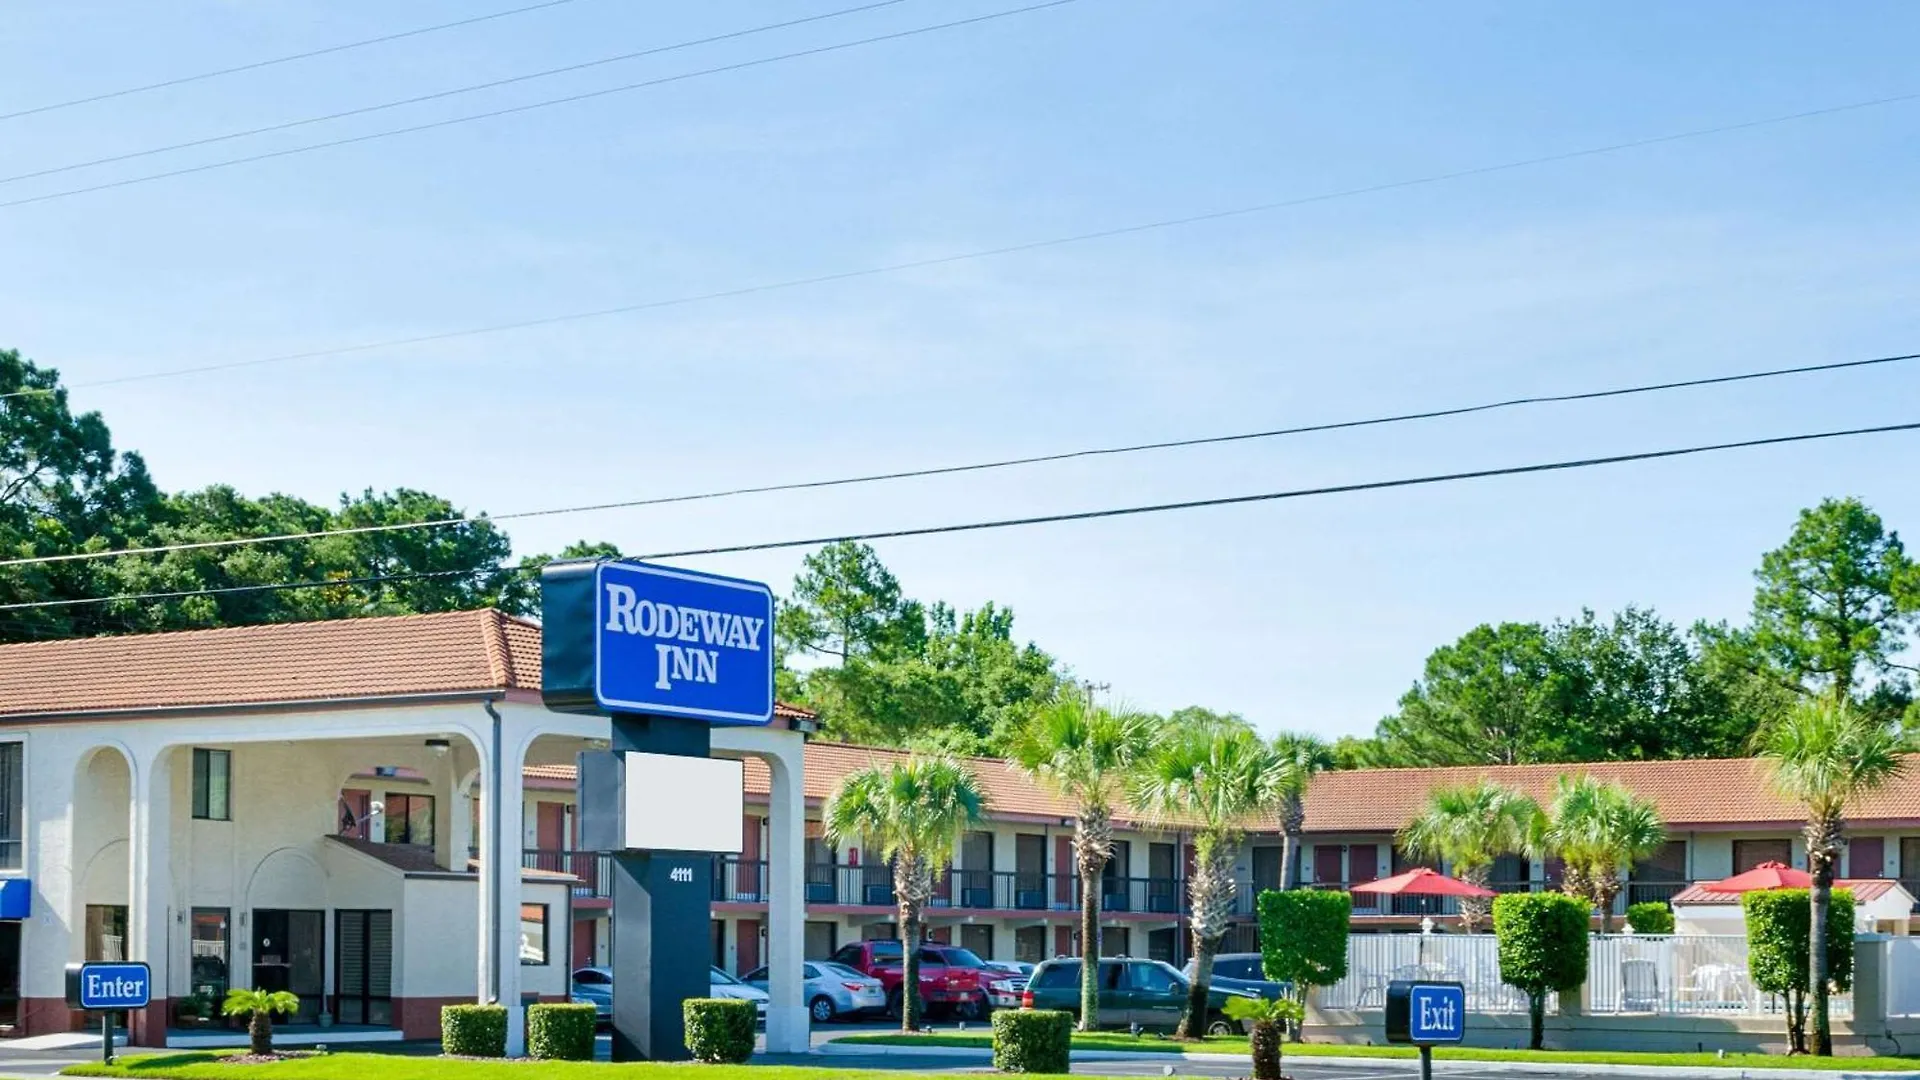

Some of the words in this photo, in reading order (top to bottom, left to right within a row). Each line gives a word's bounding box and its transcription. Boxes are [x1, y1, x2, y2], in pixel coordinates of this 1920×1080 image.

[605, 583, 765, 651] RODEWAY
[655, 643, 719, 690] INN
[670, 867, 692, 882] 4111
[87, 974, 144, 998] Enter
[1420, 996, 1455, 1031] Exit
